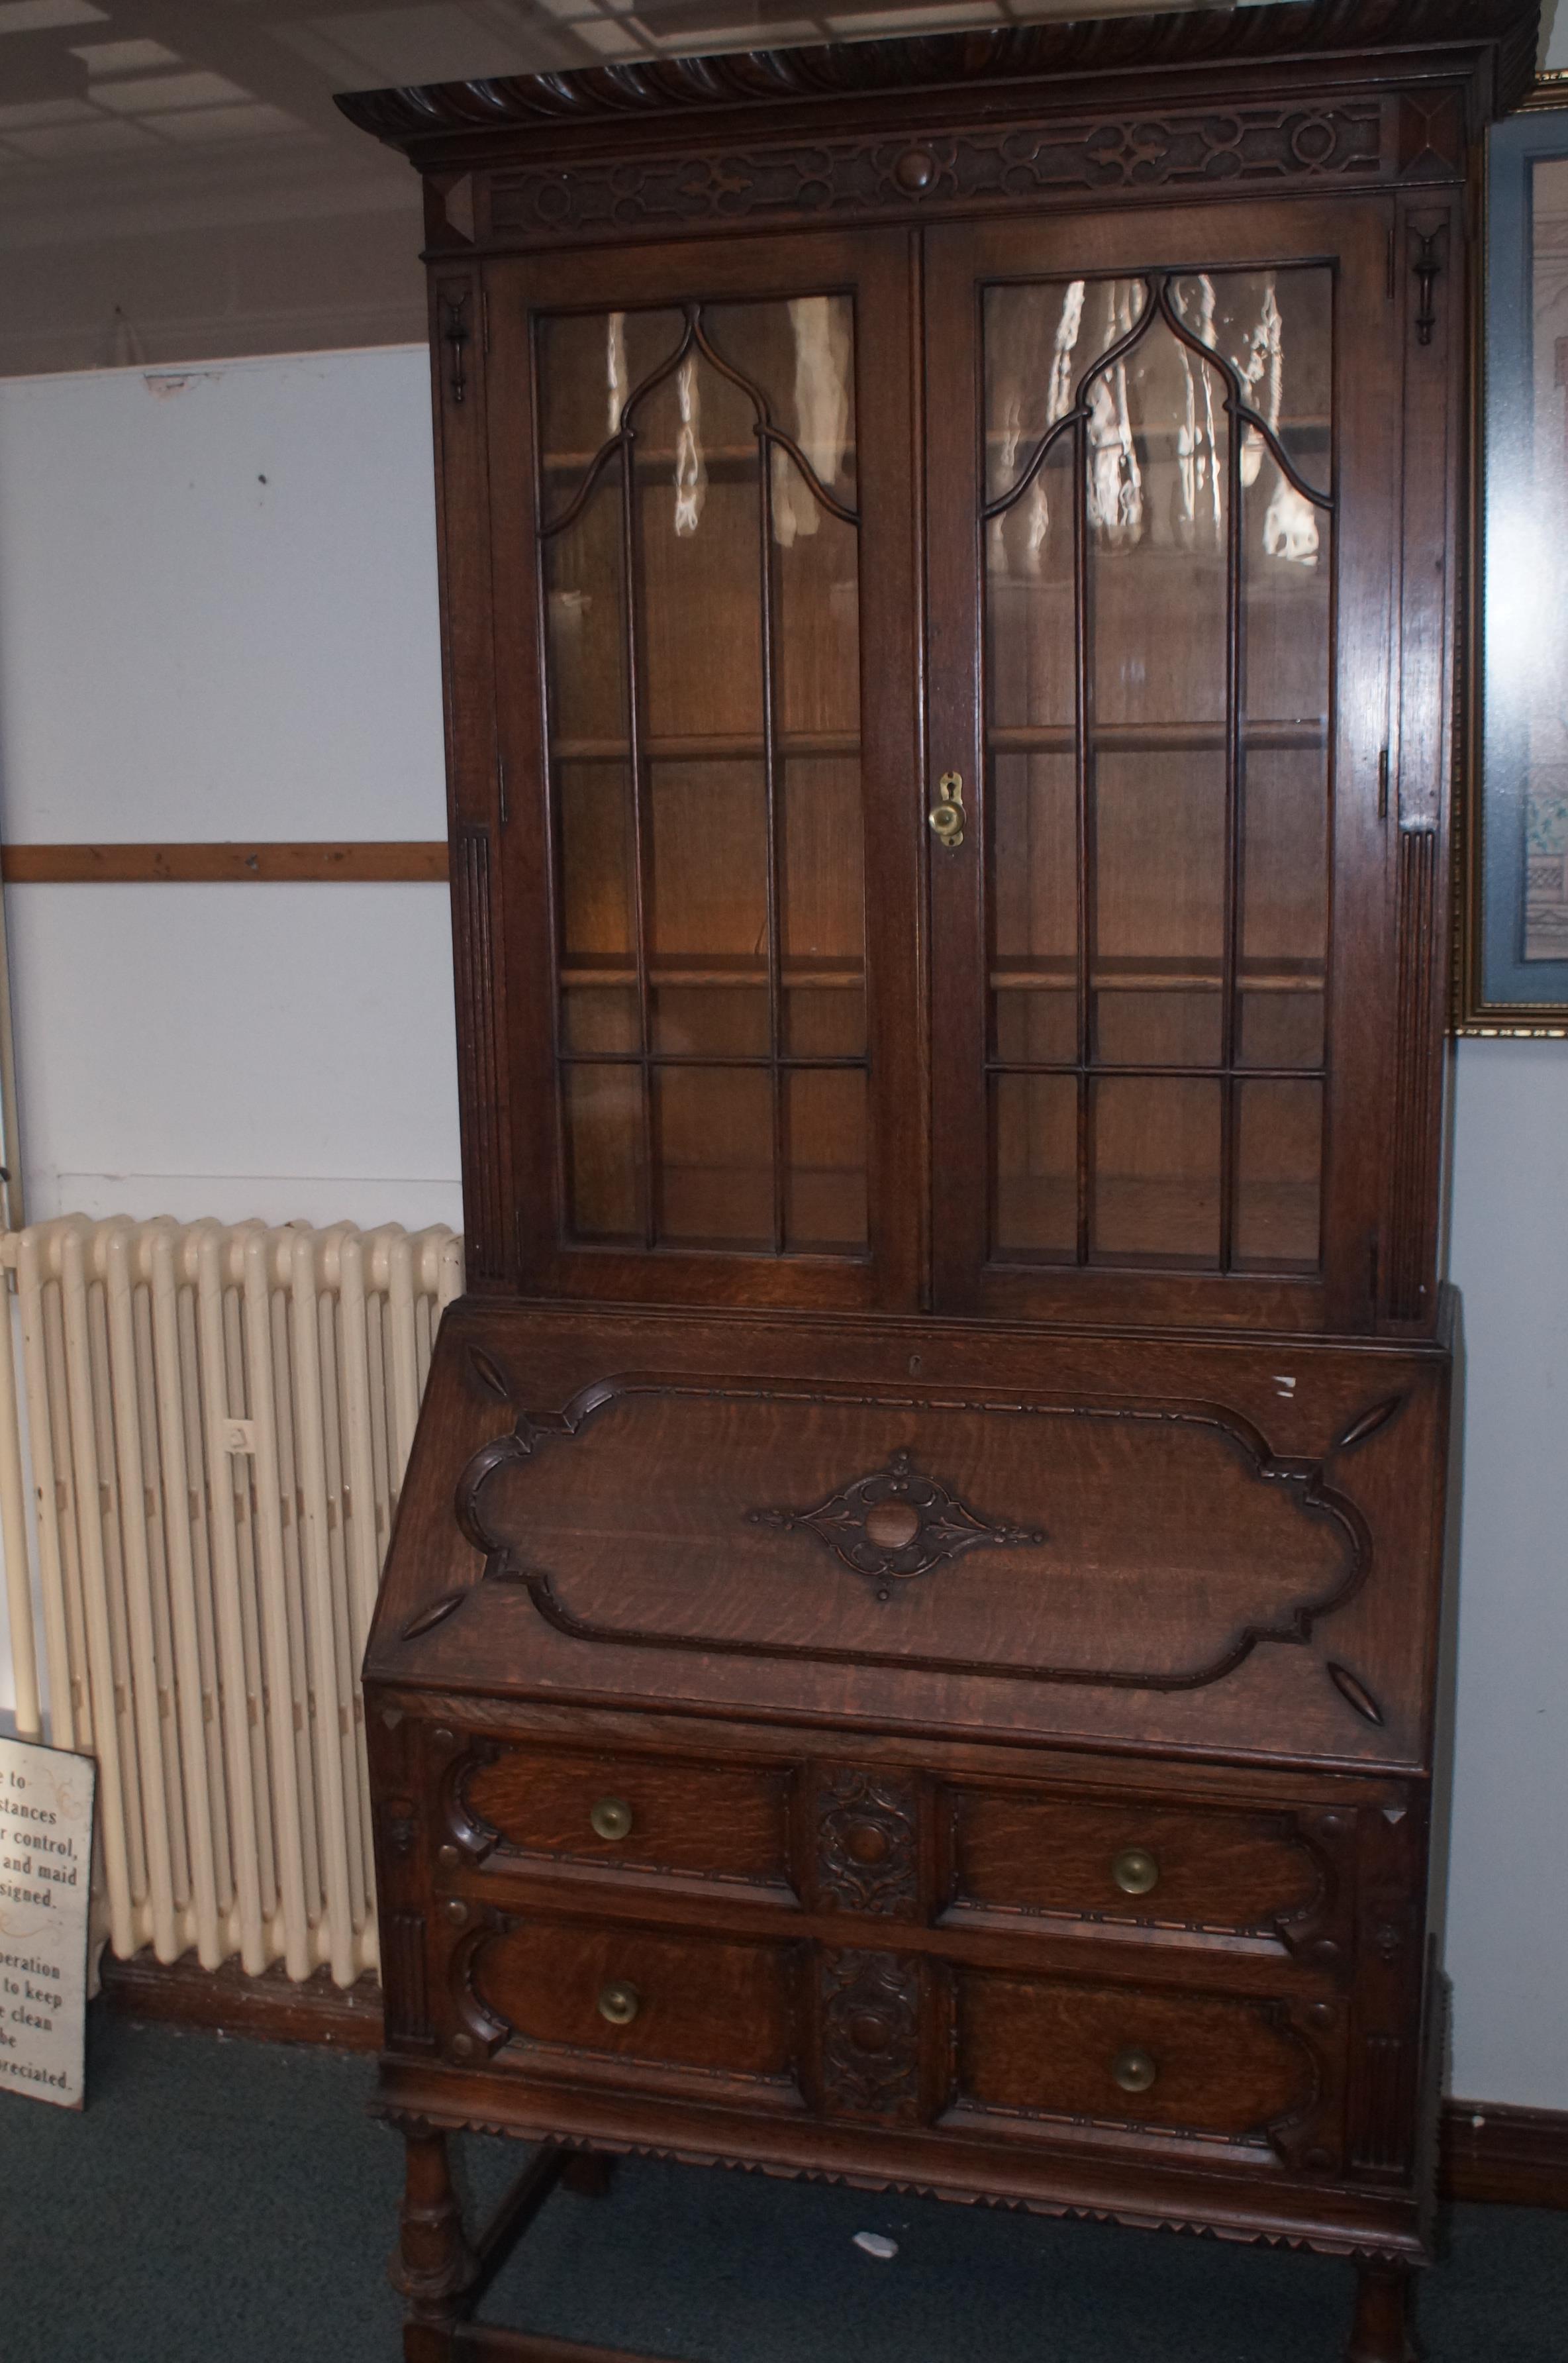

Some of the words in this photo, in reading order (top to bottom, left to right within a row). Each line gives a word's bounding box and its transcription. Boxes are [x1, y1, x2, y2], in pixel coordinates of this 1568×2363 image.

[11, 1770, 26, 1789] to
[14, 1832, 77, 1862] control,
[3, 1855, 32, 1875] and
[38, 1864, 77, 1886] maid
[4, 1977, 20, 1995] to
[25, 1980, 63, 2012] keep
[11, 2005, 53, 2032] clean
